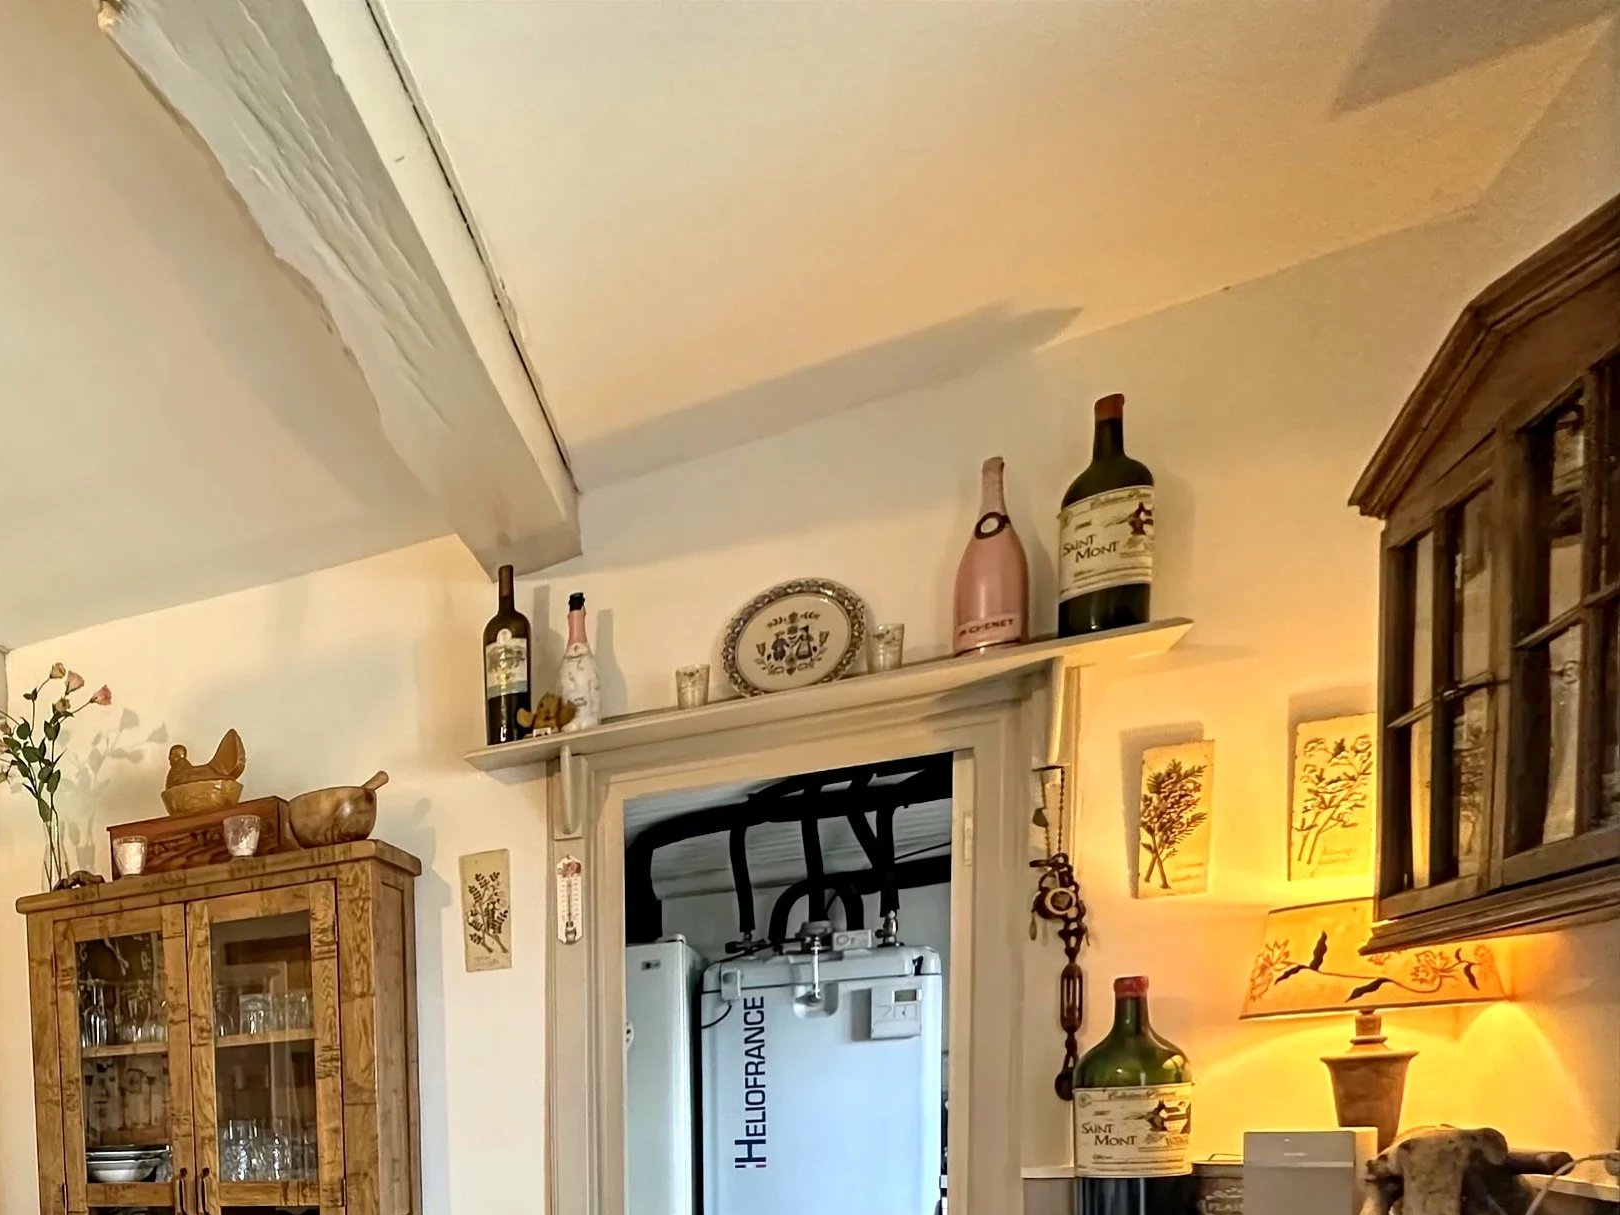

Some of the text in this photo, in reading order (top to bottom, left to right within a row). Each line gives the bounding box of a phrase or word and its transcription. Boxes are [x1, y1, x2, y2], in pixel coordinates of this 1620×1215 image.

[1063, 534, 1096, 556] SAINT
[1075, 541, 1119, 563] MONT
[1081, 1121, 1115, 1134] SAINT
[1094, 1135, 1138, 1146] MONT
